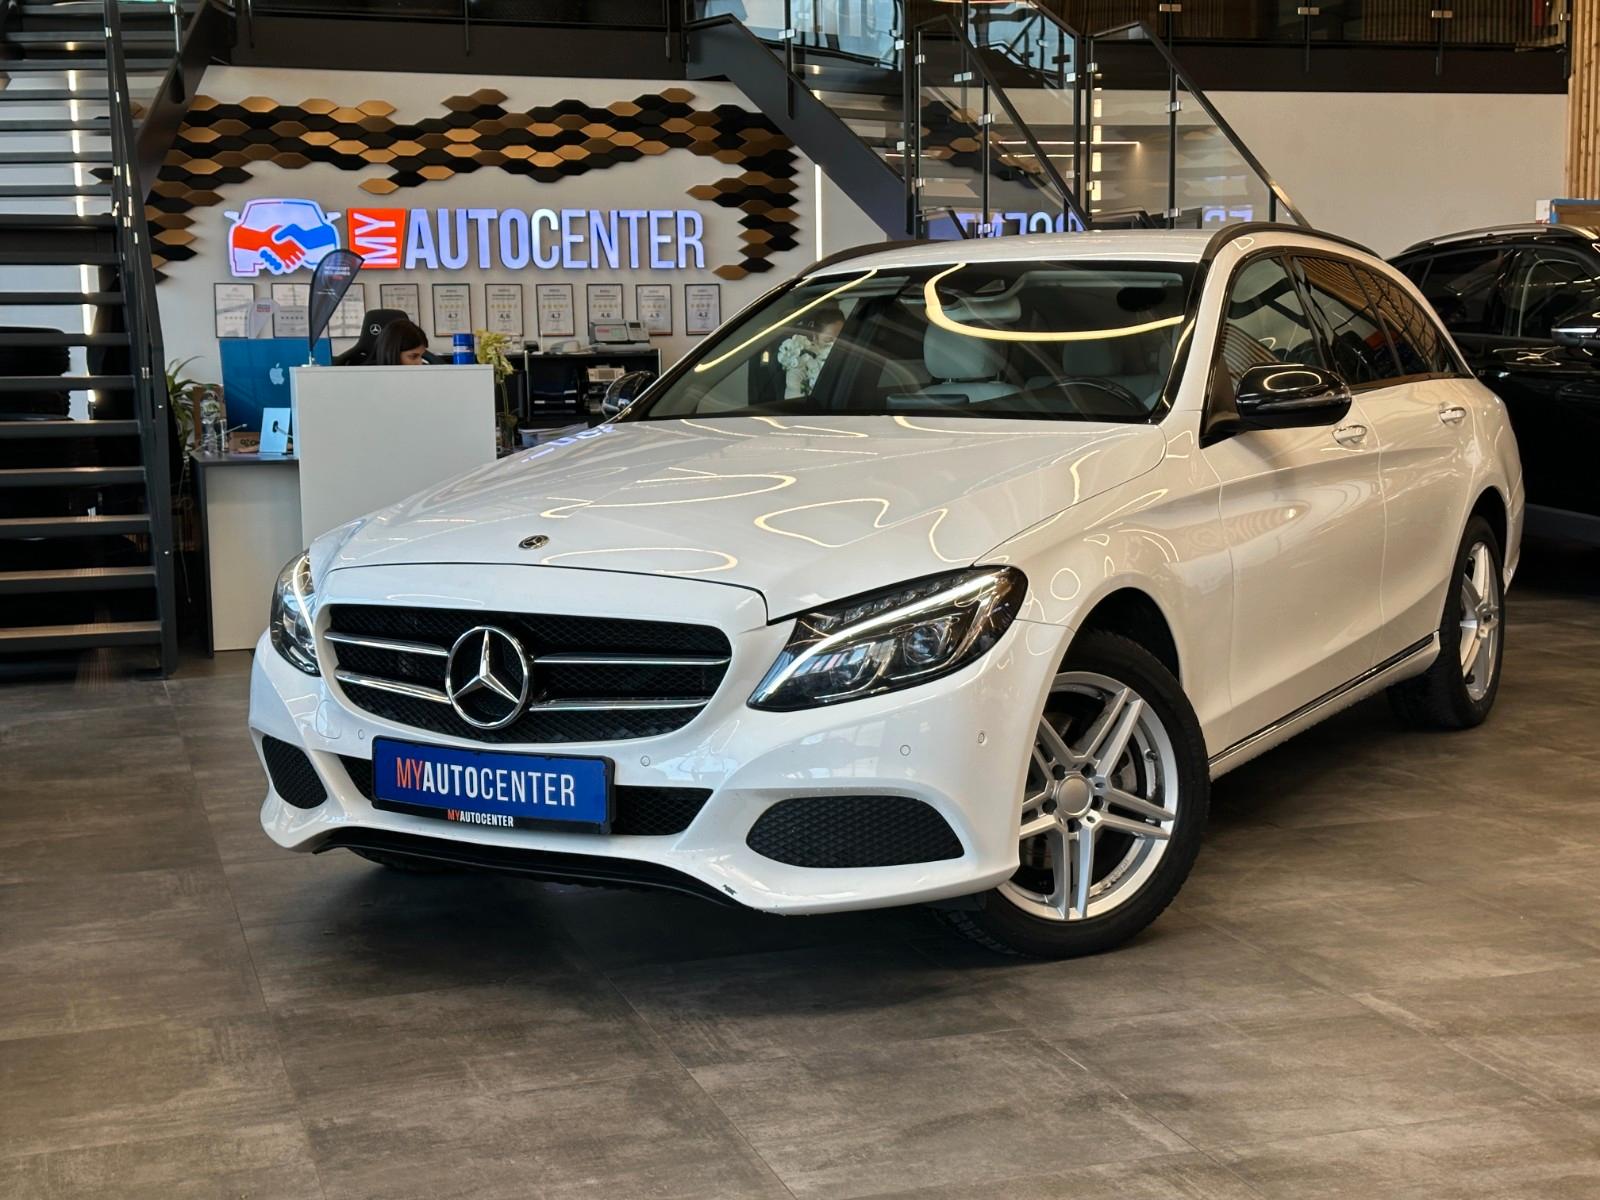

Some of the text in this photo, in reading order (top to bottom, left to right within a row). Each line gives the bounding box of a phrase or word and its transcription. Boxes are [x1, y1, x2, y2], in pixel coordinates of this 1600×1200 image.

[353, 208, 705, 269] MY AUTOCENTER
[396, 757, 576, 807] MYAUTOCENTER
[447, 809, 514, 828] MYAUTOCENTER
